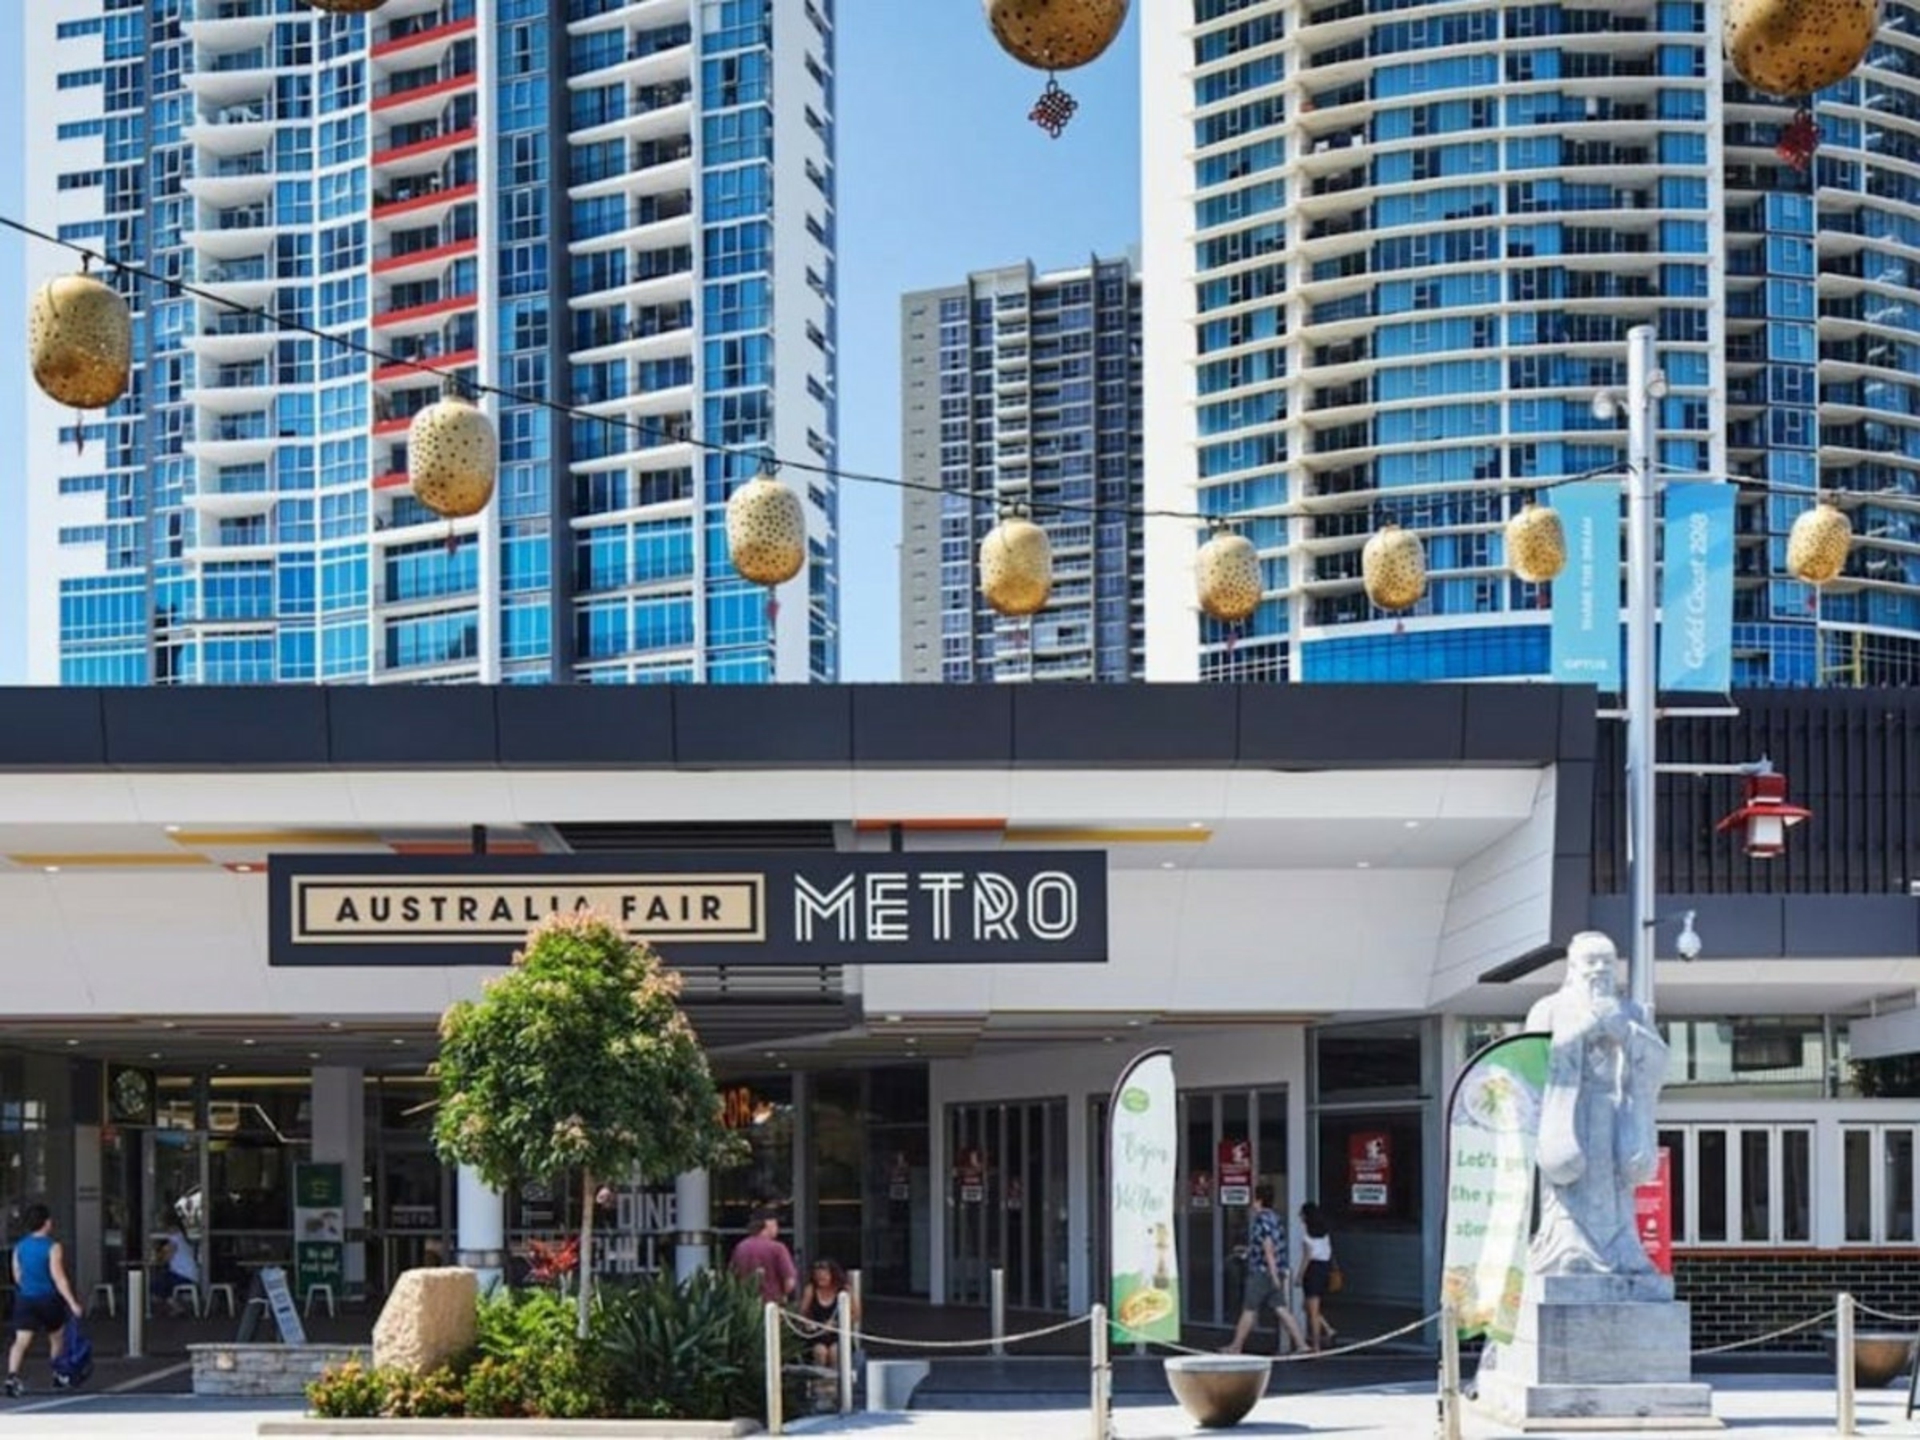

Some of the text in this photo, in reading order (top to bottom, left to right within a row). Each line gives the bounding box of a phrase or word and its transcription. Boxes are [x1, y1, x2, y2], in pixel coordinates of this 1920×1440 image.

[1686, 557, 1706, 612] Coast
[1685, 617, 1706, 669] Gold
[621, 895, 722, 921] FAIR
[794, 871, 1078, 941] METRO
[1457, 1149, 1498, 1169] Let's
[617, 1192, 678, 1230] DINE
[1451, 1184, 1481, 1202] the
